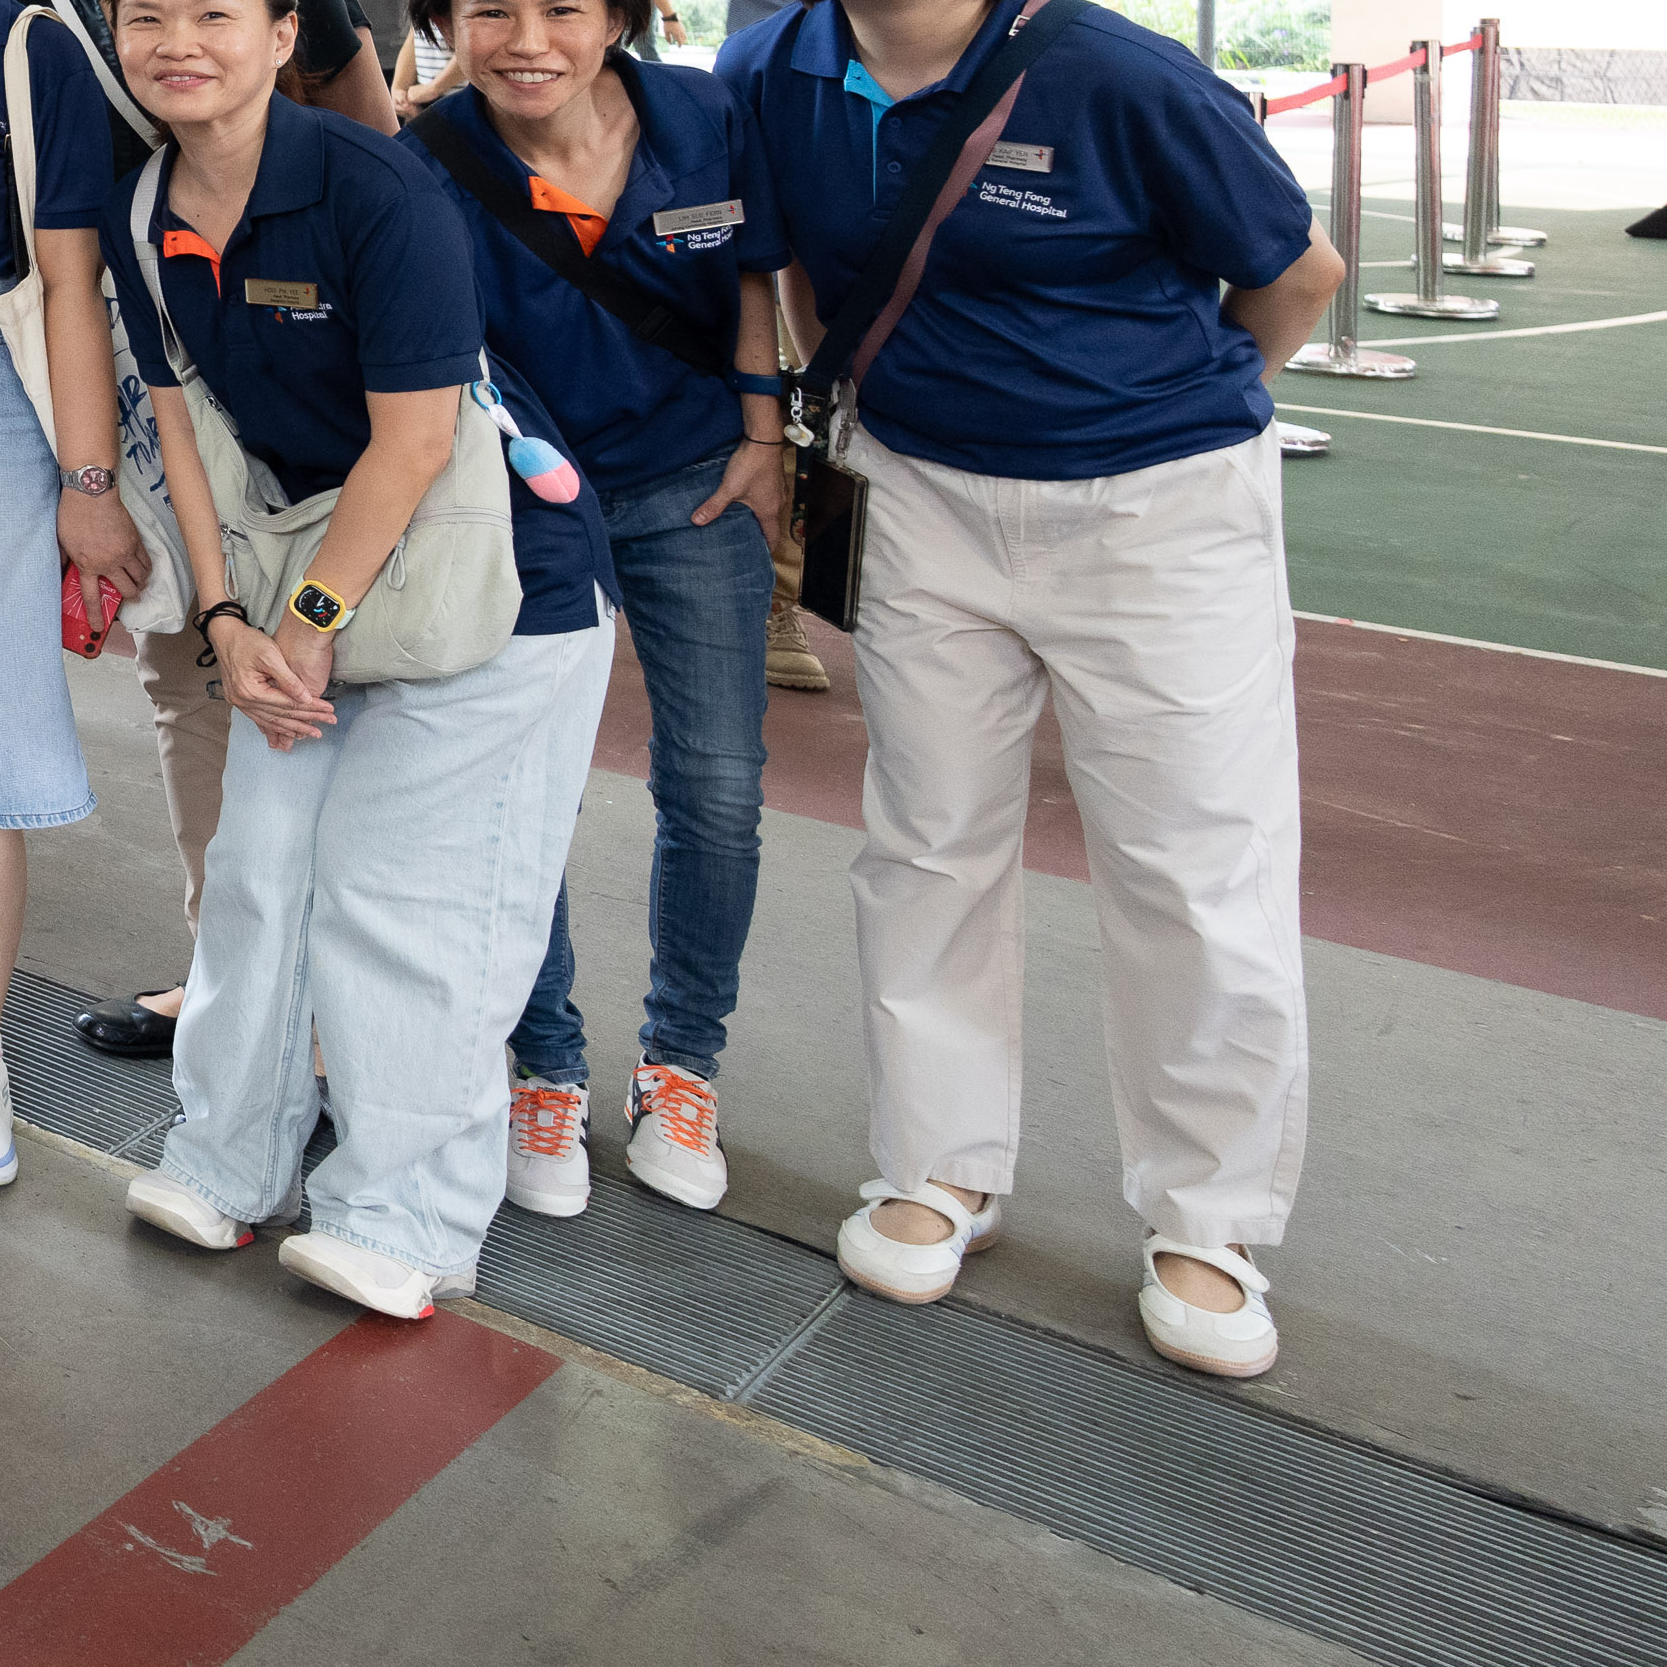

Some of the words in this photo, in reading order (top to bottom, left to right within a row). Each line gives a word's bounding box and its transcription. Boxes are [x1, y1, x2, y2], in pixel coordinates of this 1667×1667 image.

[982, 182, 997, 194] Ng
[998, 184, 1023, 200] Teng
[1024, 191, 1051, 206] Fong
[979, 191, 1020, 208] General
[1021, 201, 1067, 218] Hospital
[687, 234, 701, 242] Ng
[702, 230, 721, 241] Teng
[688, 238, 721, 249] General
[291, 311, 328, 322] Hospital
